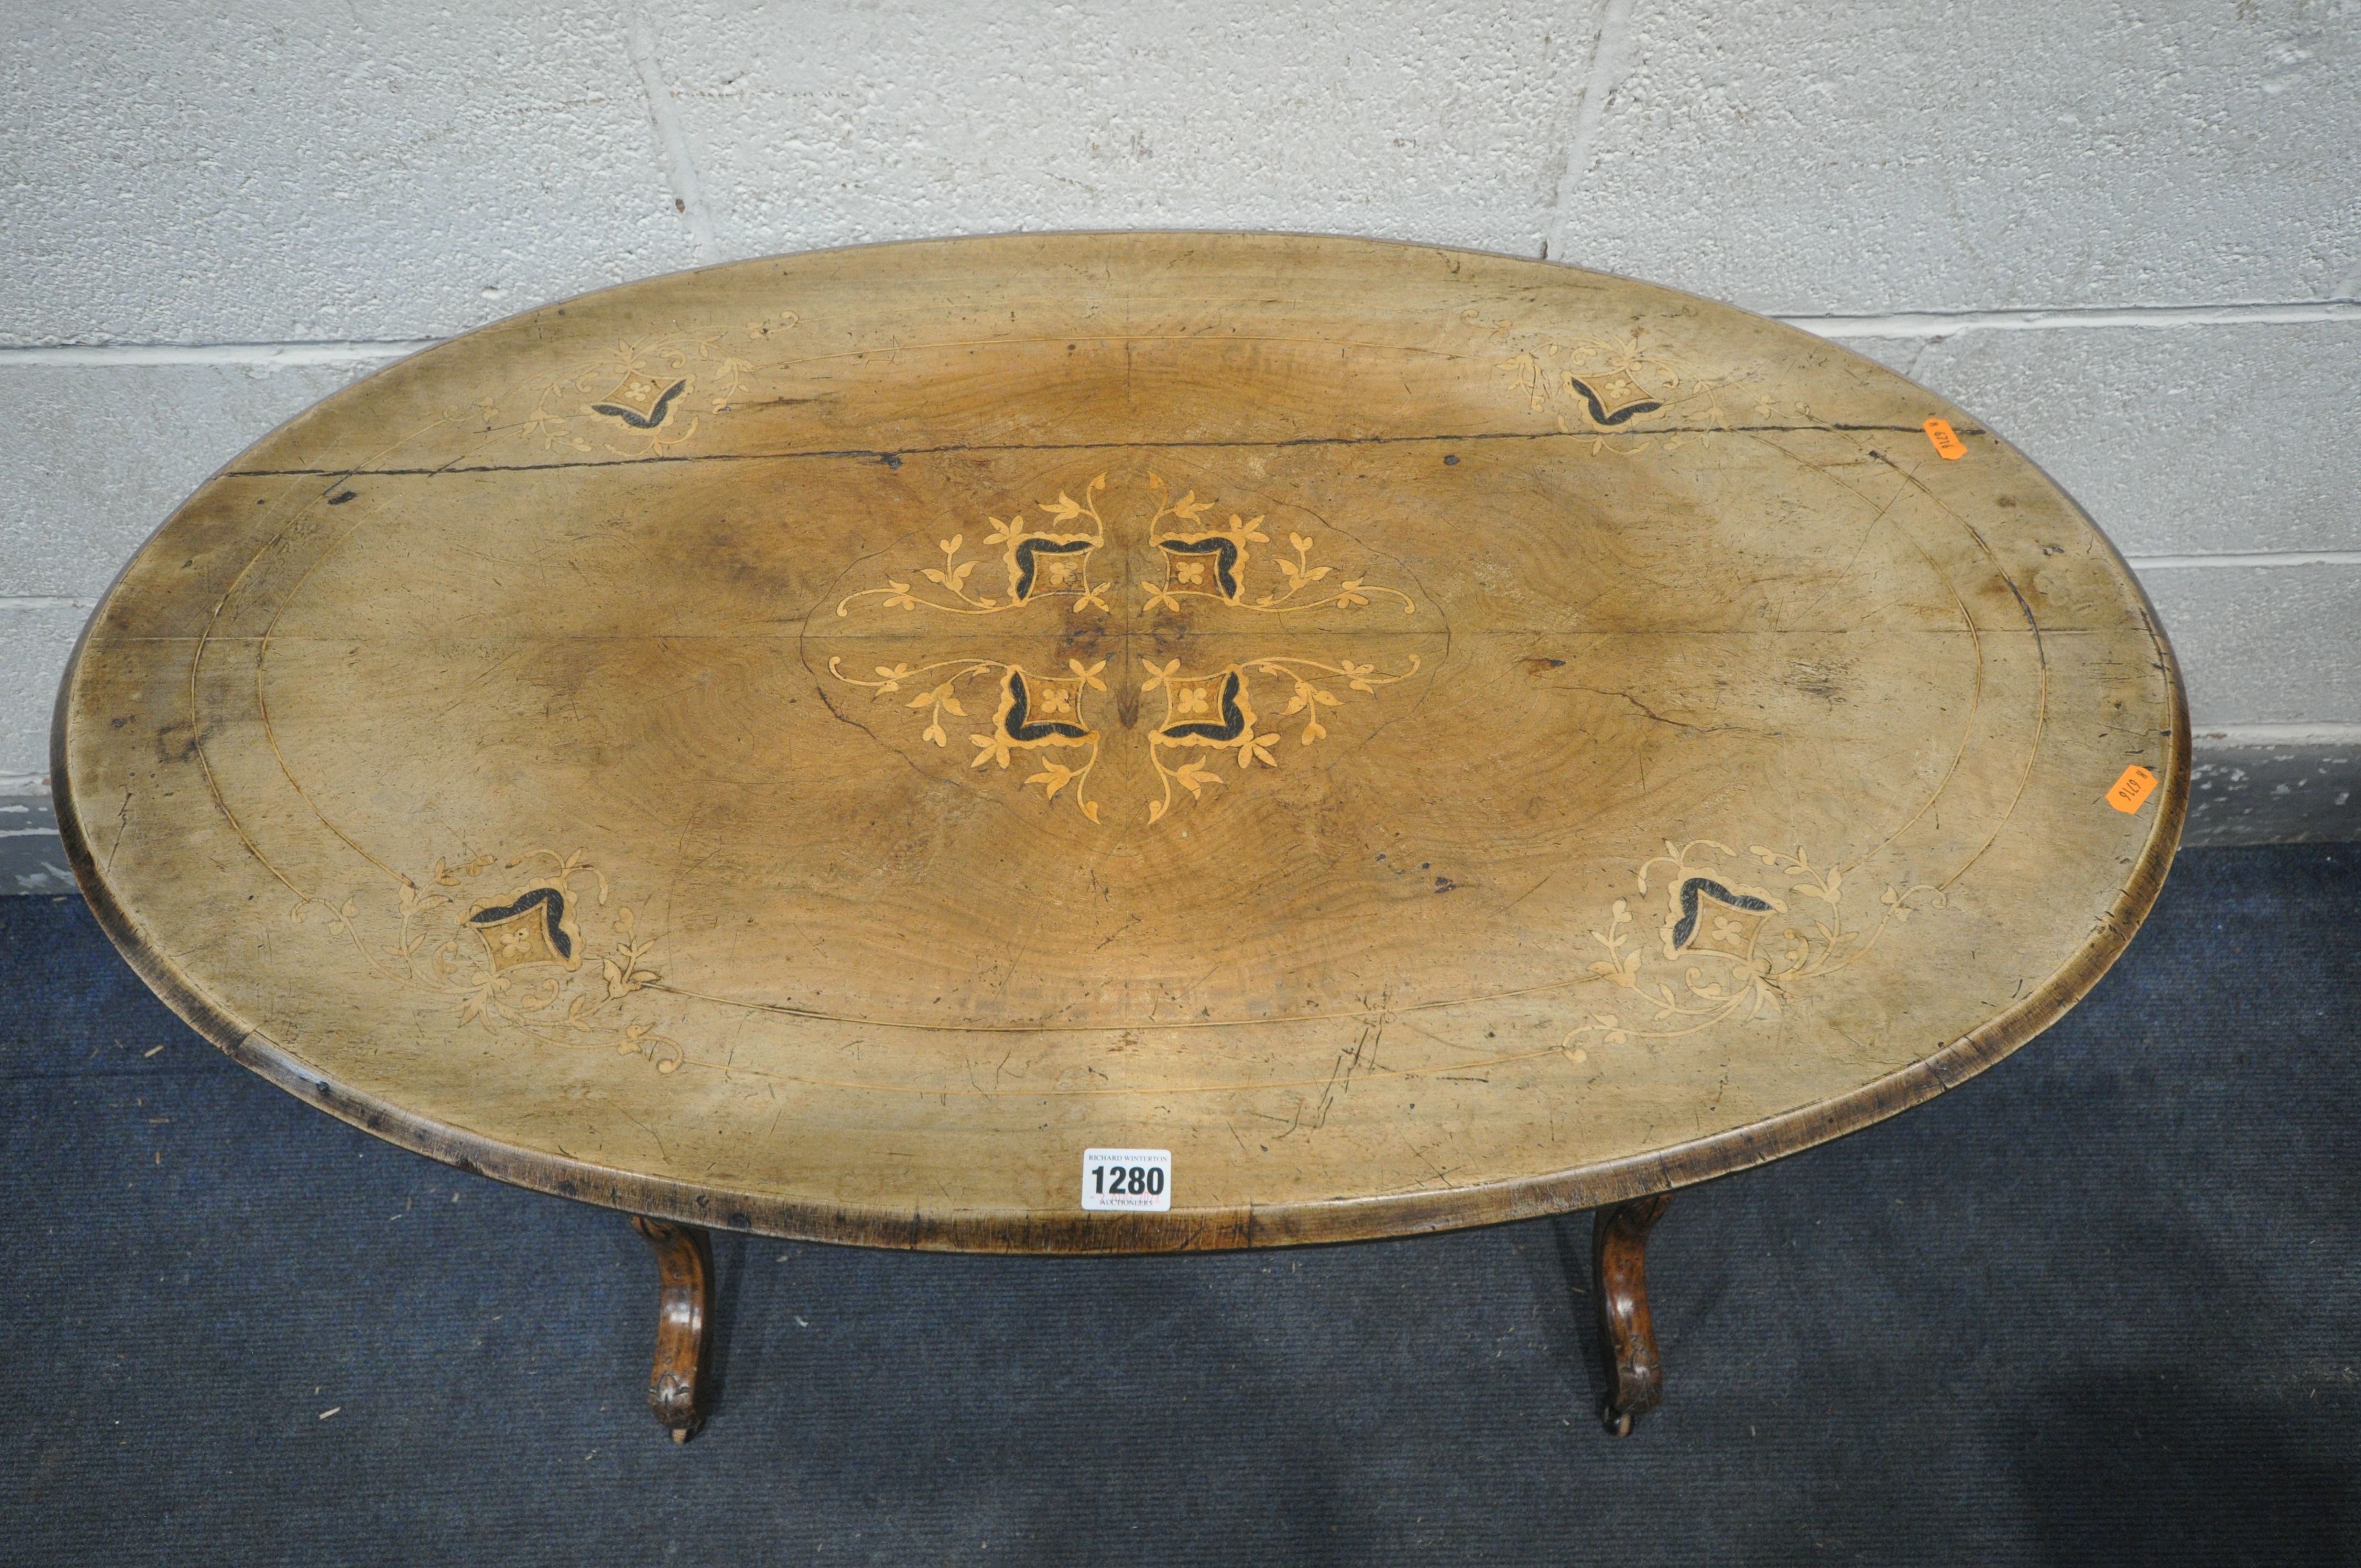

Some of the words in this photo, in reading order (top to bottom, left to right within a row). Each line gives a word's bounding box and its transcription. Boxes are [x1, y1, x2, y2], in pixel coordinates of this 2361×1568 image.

[1934, 432, 1954, 449] 6716
[2119, 779, 2141, 801] 6716
[1092, 1166, 1165, 1195] 1280
